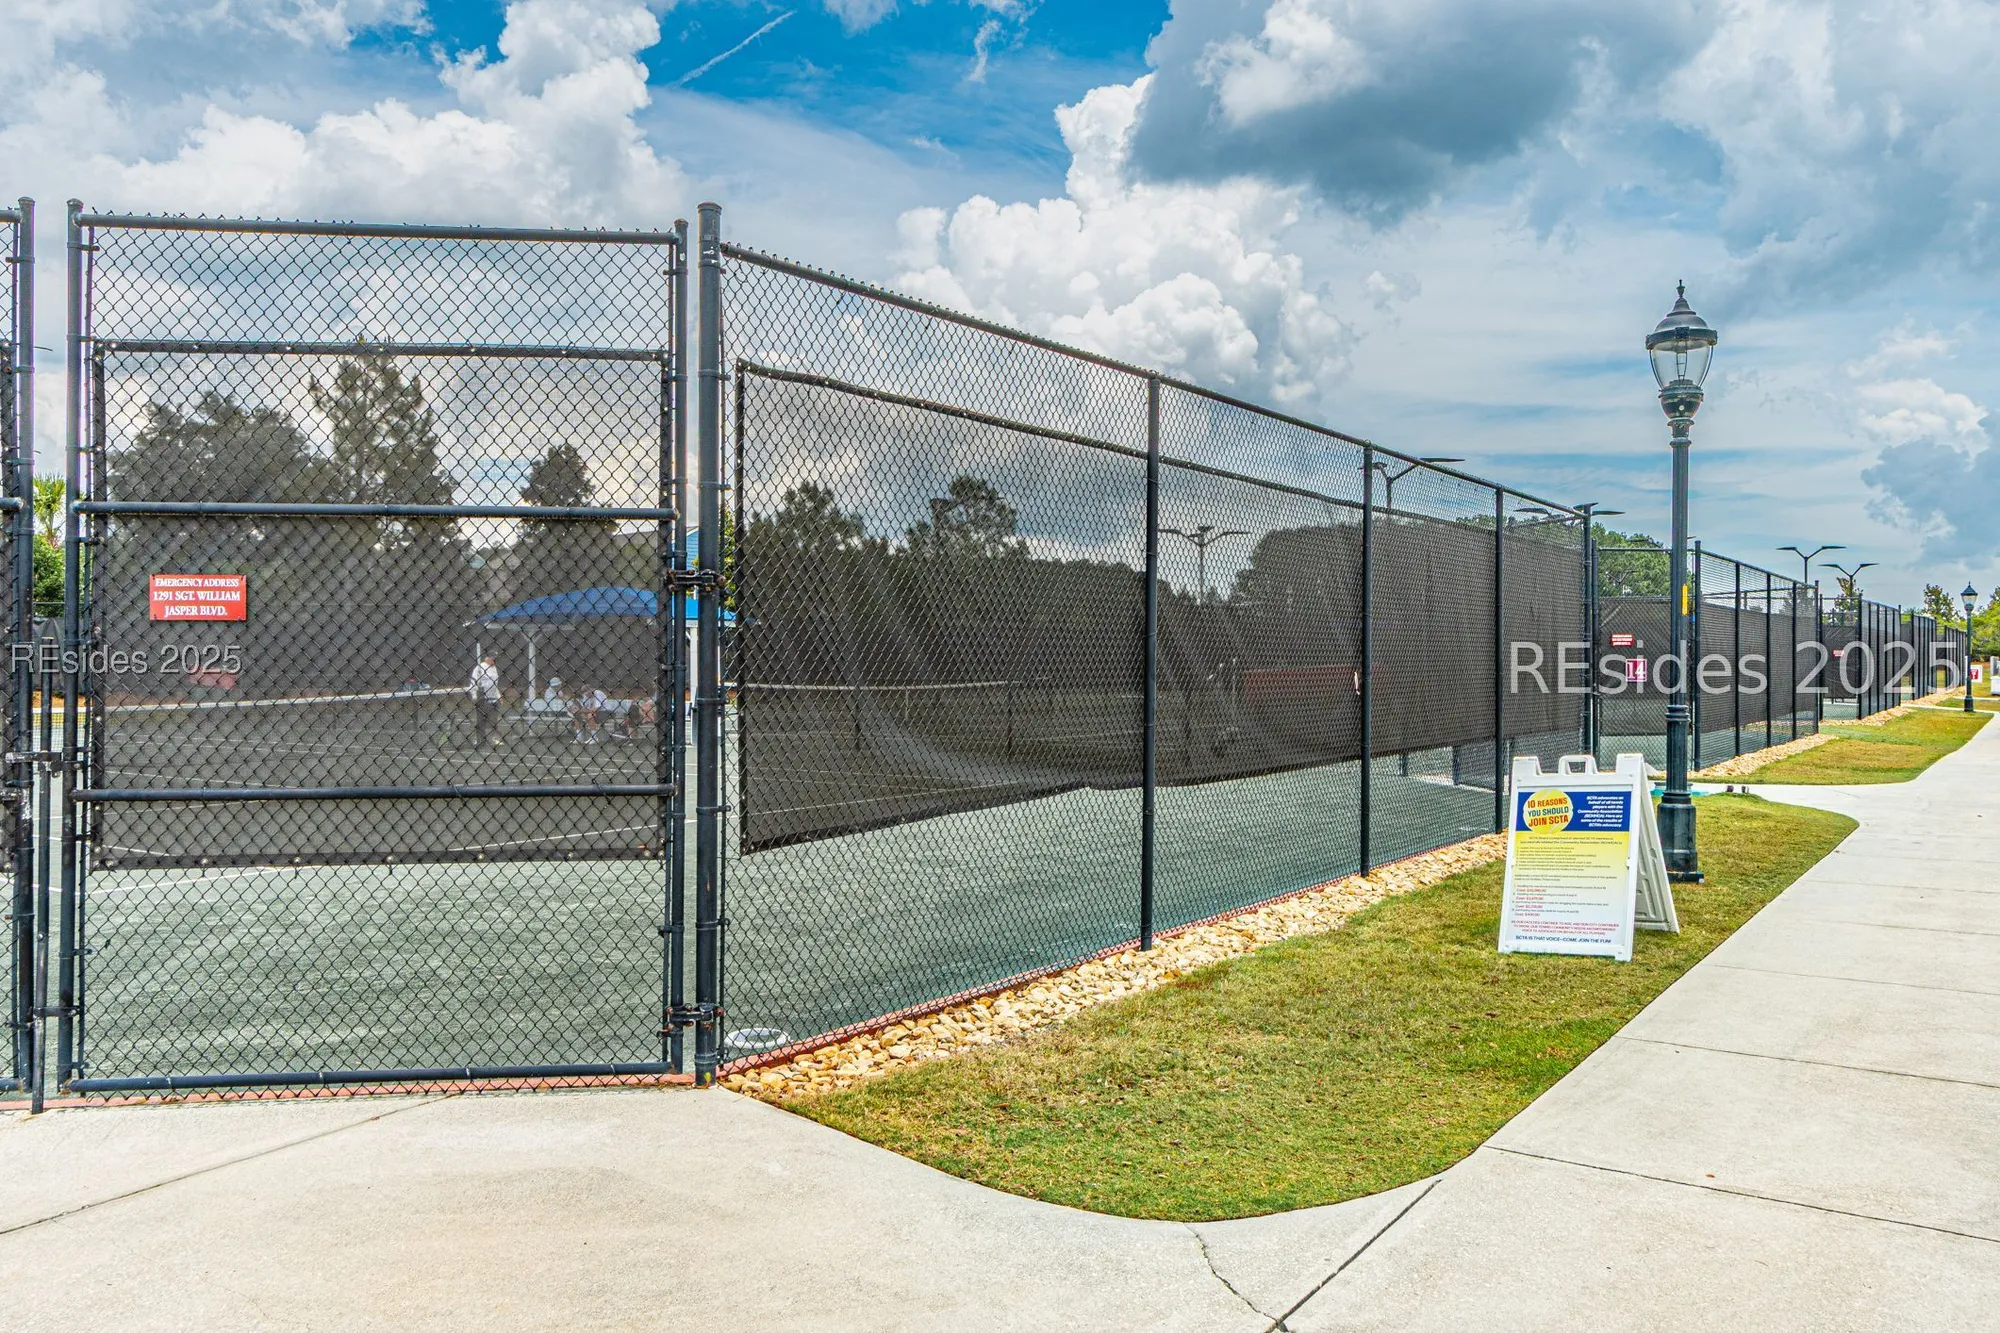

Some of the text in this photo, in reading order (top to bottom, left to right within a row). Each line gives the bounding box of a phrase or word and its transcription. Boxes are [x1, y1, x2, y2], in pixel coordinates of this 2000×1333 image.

[155, 578, 239, 587] EMERGENCY ADDRESS
[153, 591, 173, 601] 1291
[196, 591, 240, 601] WILLIAM
[164, 606, 227, 617] JASPER BLVD.
[1627, 662, 1645, 679] 14
[1528, 798, 1567, 808] 10 REASONS
[1528, 806, 1569, 817] YOU SHOULD
[1529, 815, 1569, 827] JOIN SCTA
